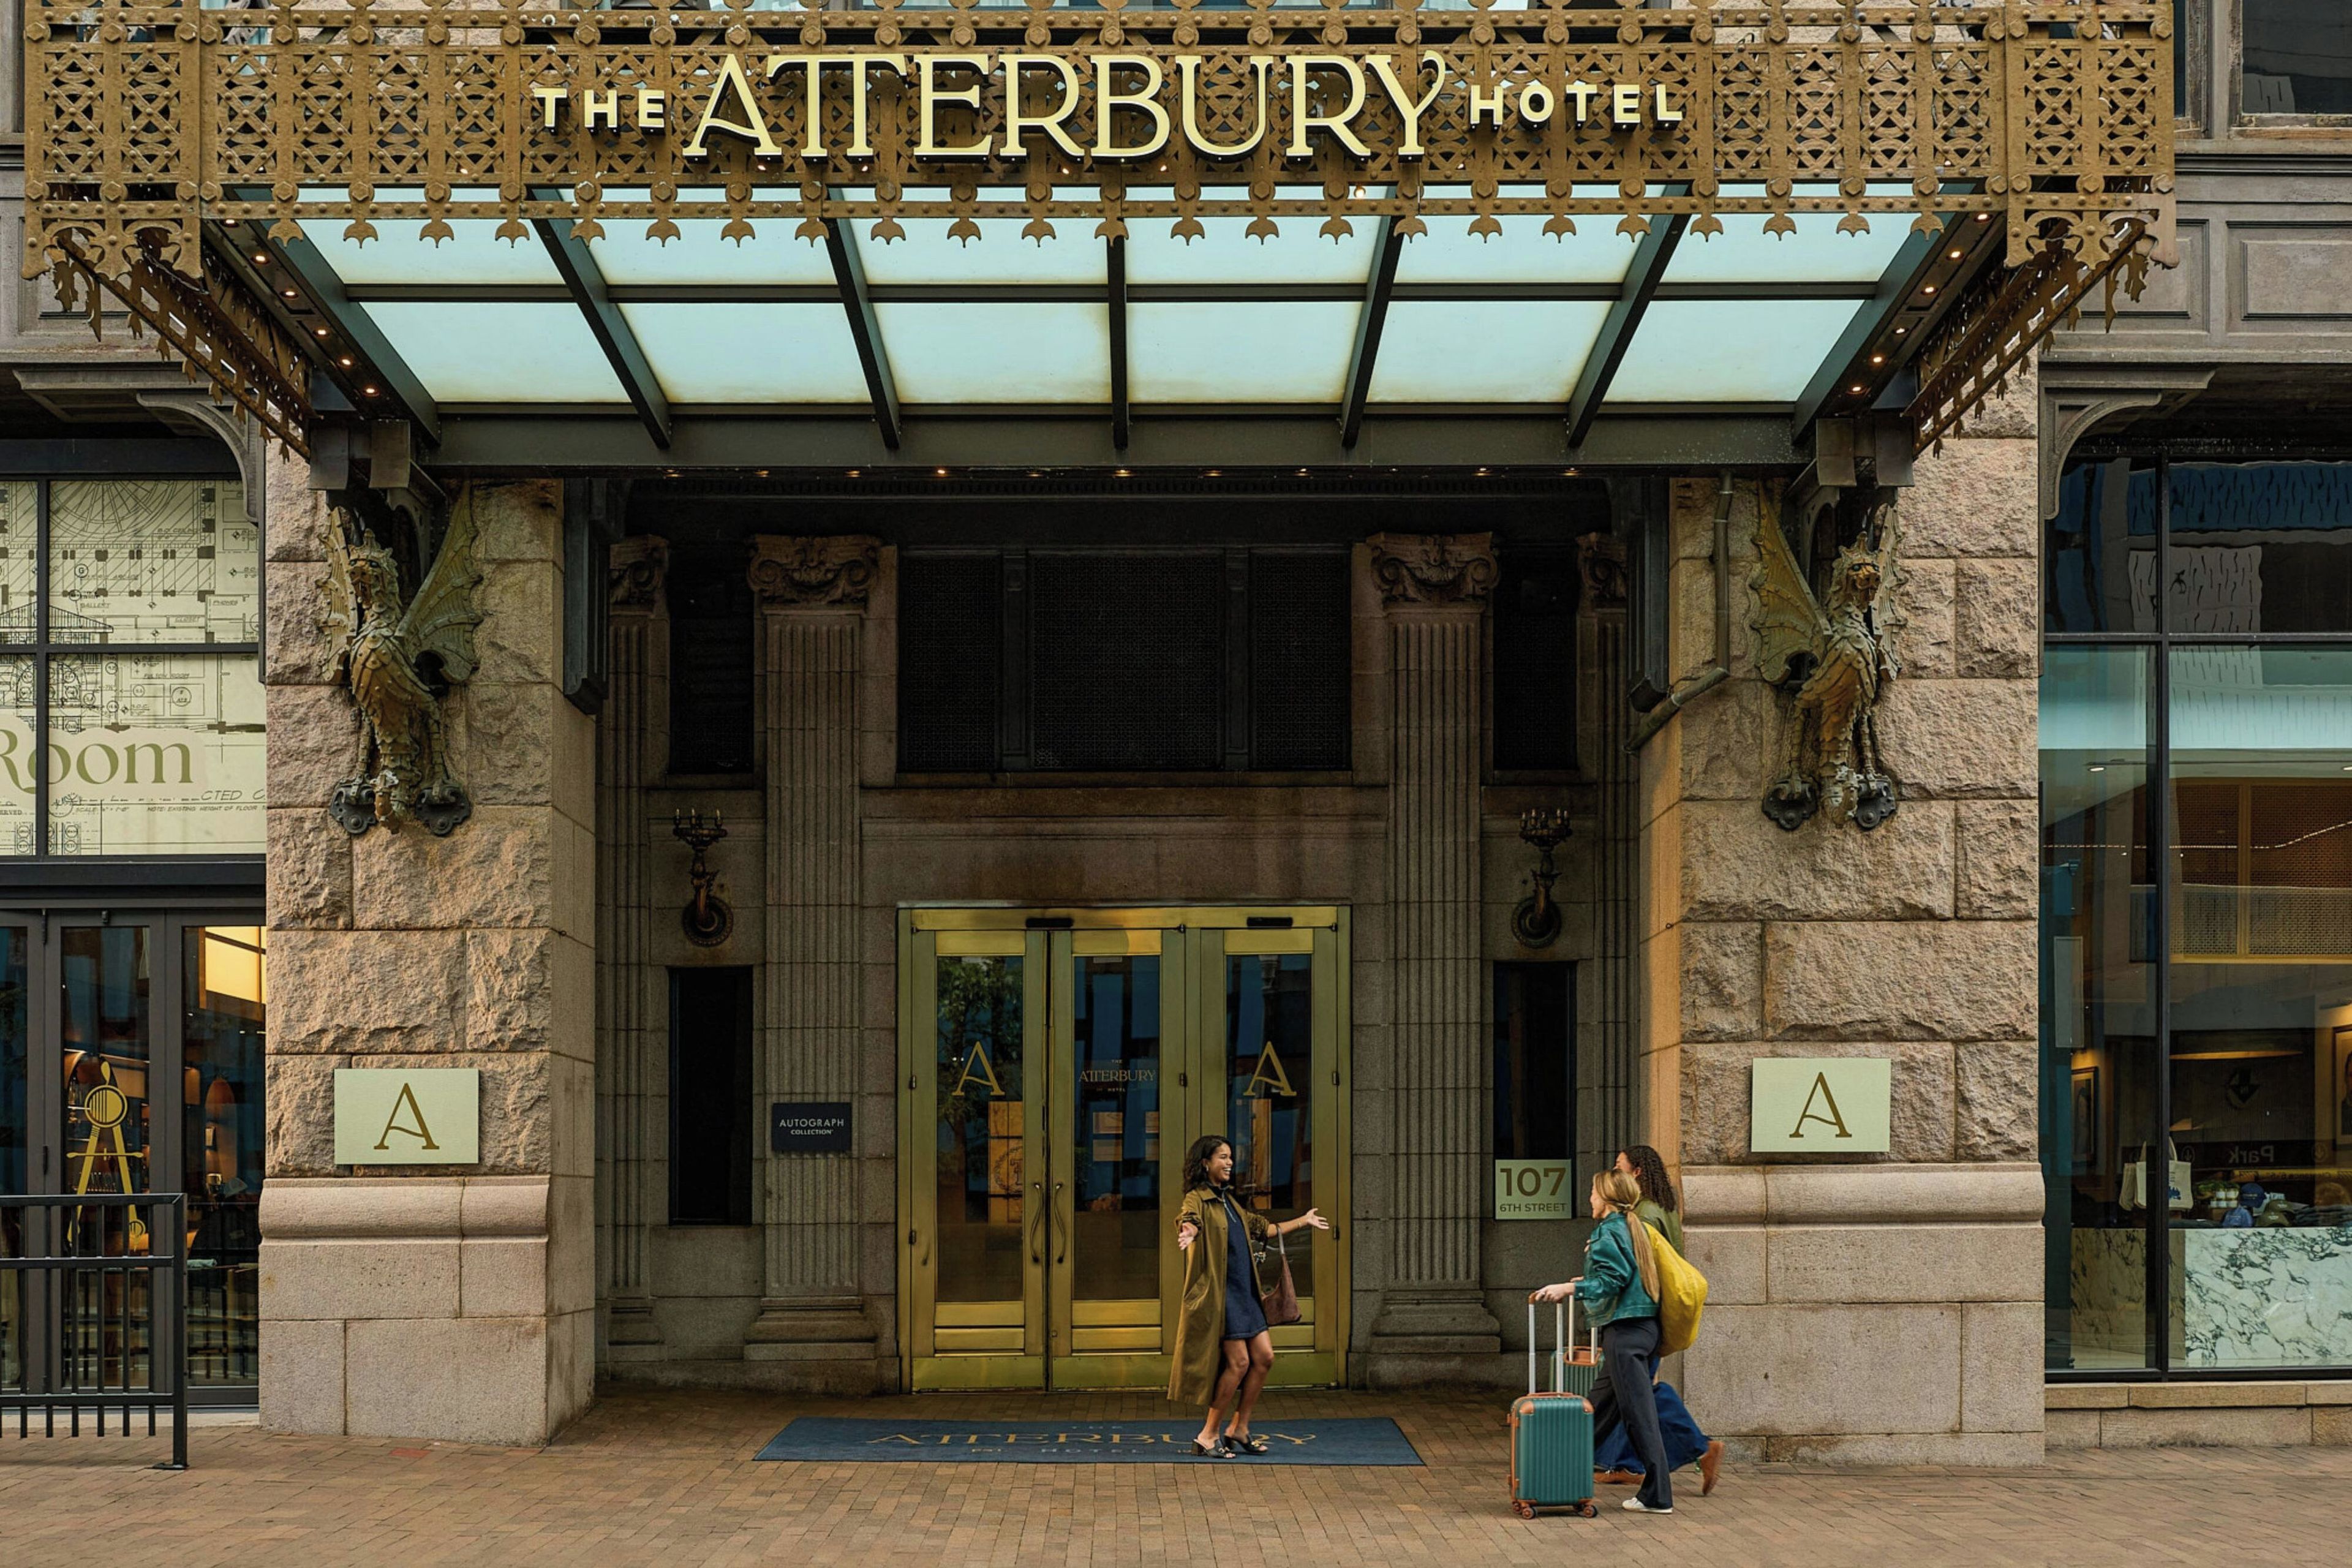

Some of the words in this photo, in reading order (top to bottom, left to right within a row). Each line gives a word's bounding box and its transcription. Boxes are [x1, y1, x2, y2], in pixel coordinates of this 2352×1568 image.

[534, 88, 665, 127] THE
[682, 50, 1446, 156] ATTERBURY
[1470, 83, 1683, 126] HOTEL
[952, 1041, 1005, 1096] A
[1078, 1069, 1156, 1082] ATTERBURY
[1243, 1041, 1297, 1096] A
[373, 1083, 439, 1150] A
[779, 1118, 845, 1128] AUTOGRAPH
[1789, 1072, 1852, 1138] A
[1500, 1167, 1566, 1197] 107
[1500, 1204, 1521, 1212] 6TH
[1525, 1203, 1568, 1212] STREET
